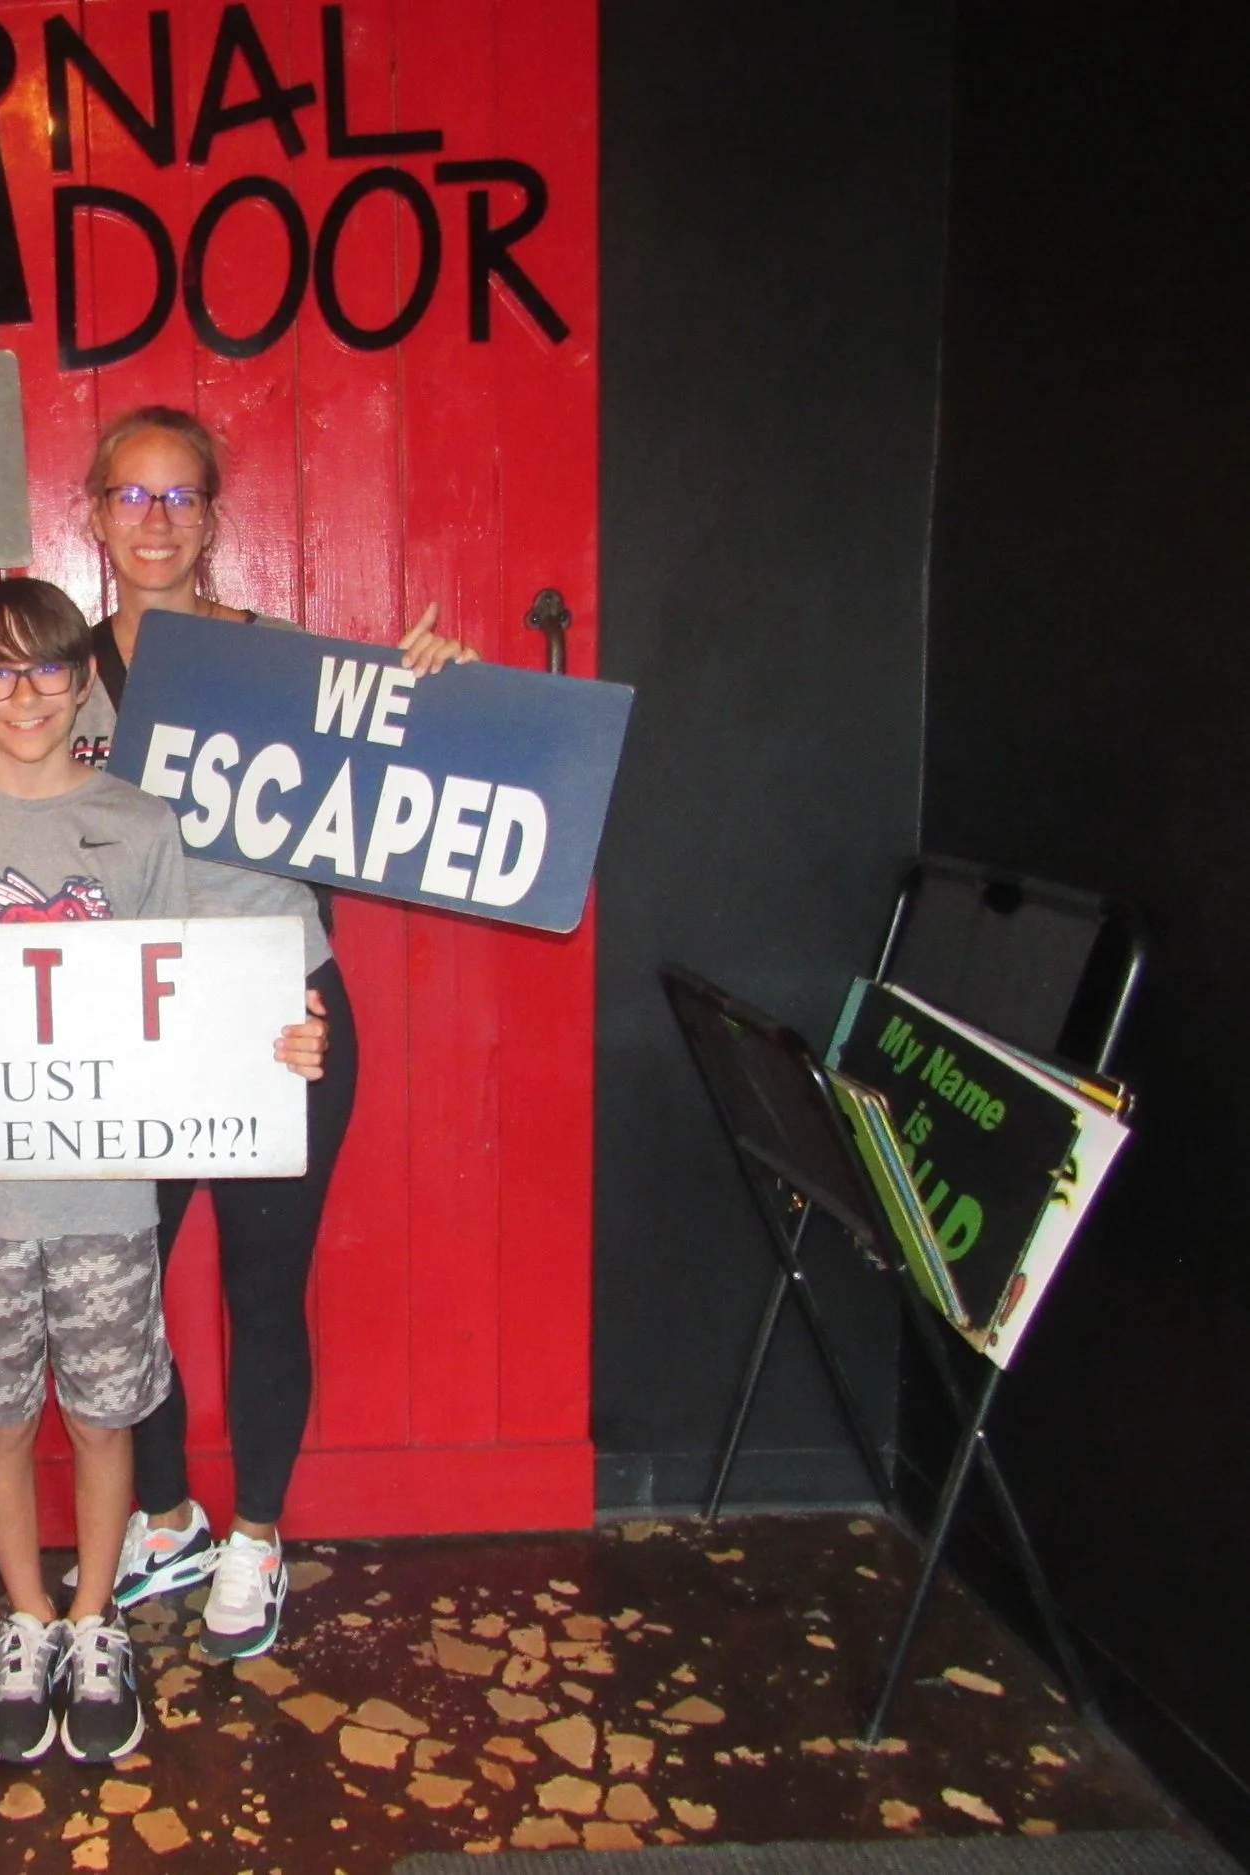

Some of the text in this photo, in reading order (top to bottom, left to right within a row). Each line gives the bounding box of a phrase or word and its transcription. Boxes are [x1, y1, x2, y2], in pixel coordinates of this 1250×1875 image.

[53, 158, 572, 370] DOOR
[313, 655, 417, 748] WE
[139, 722, 548, 908] ESCAPED
[877, 1015, 1007, 1131] My Name
[902, 1100, 934, 1145] is
